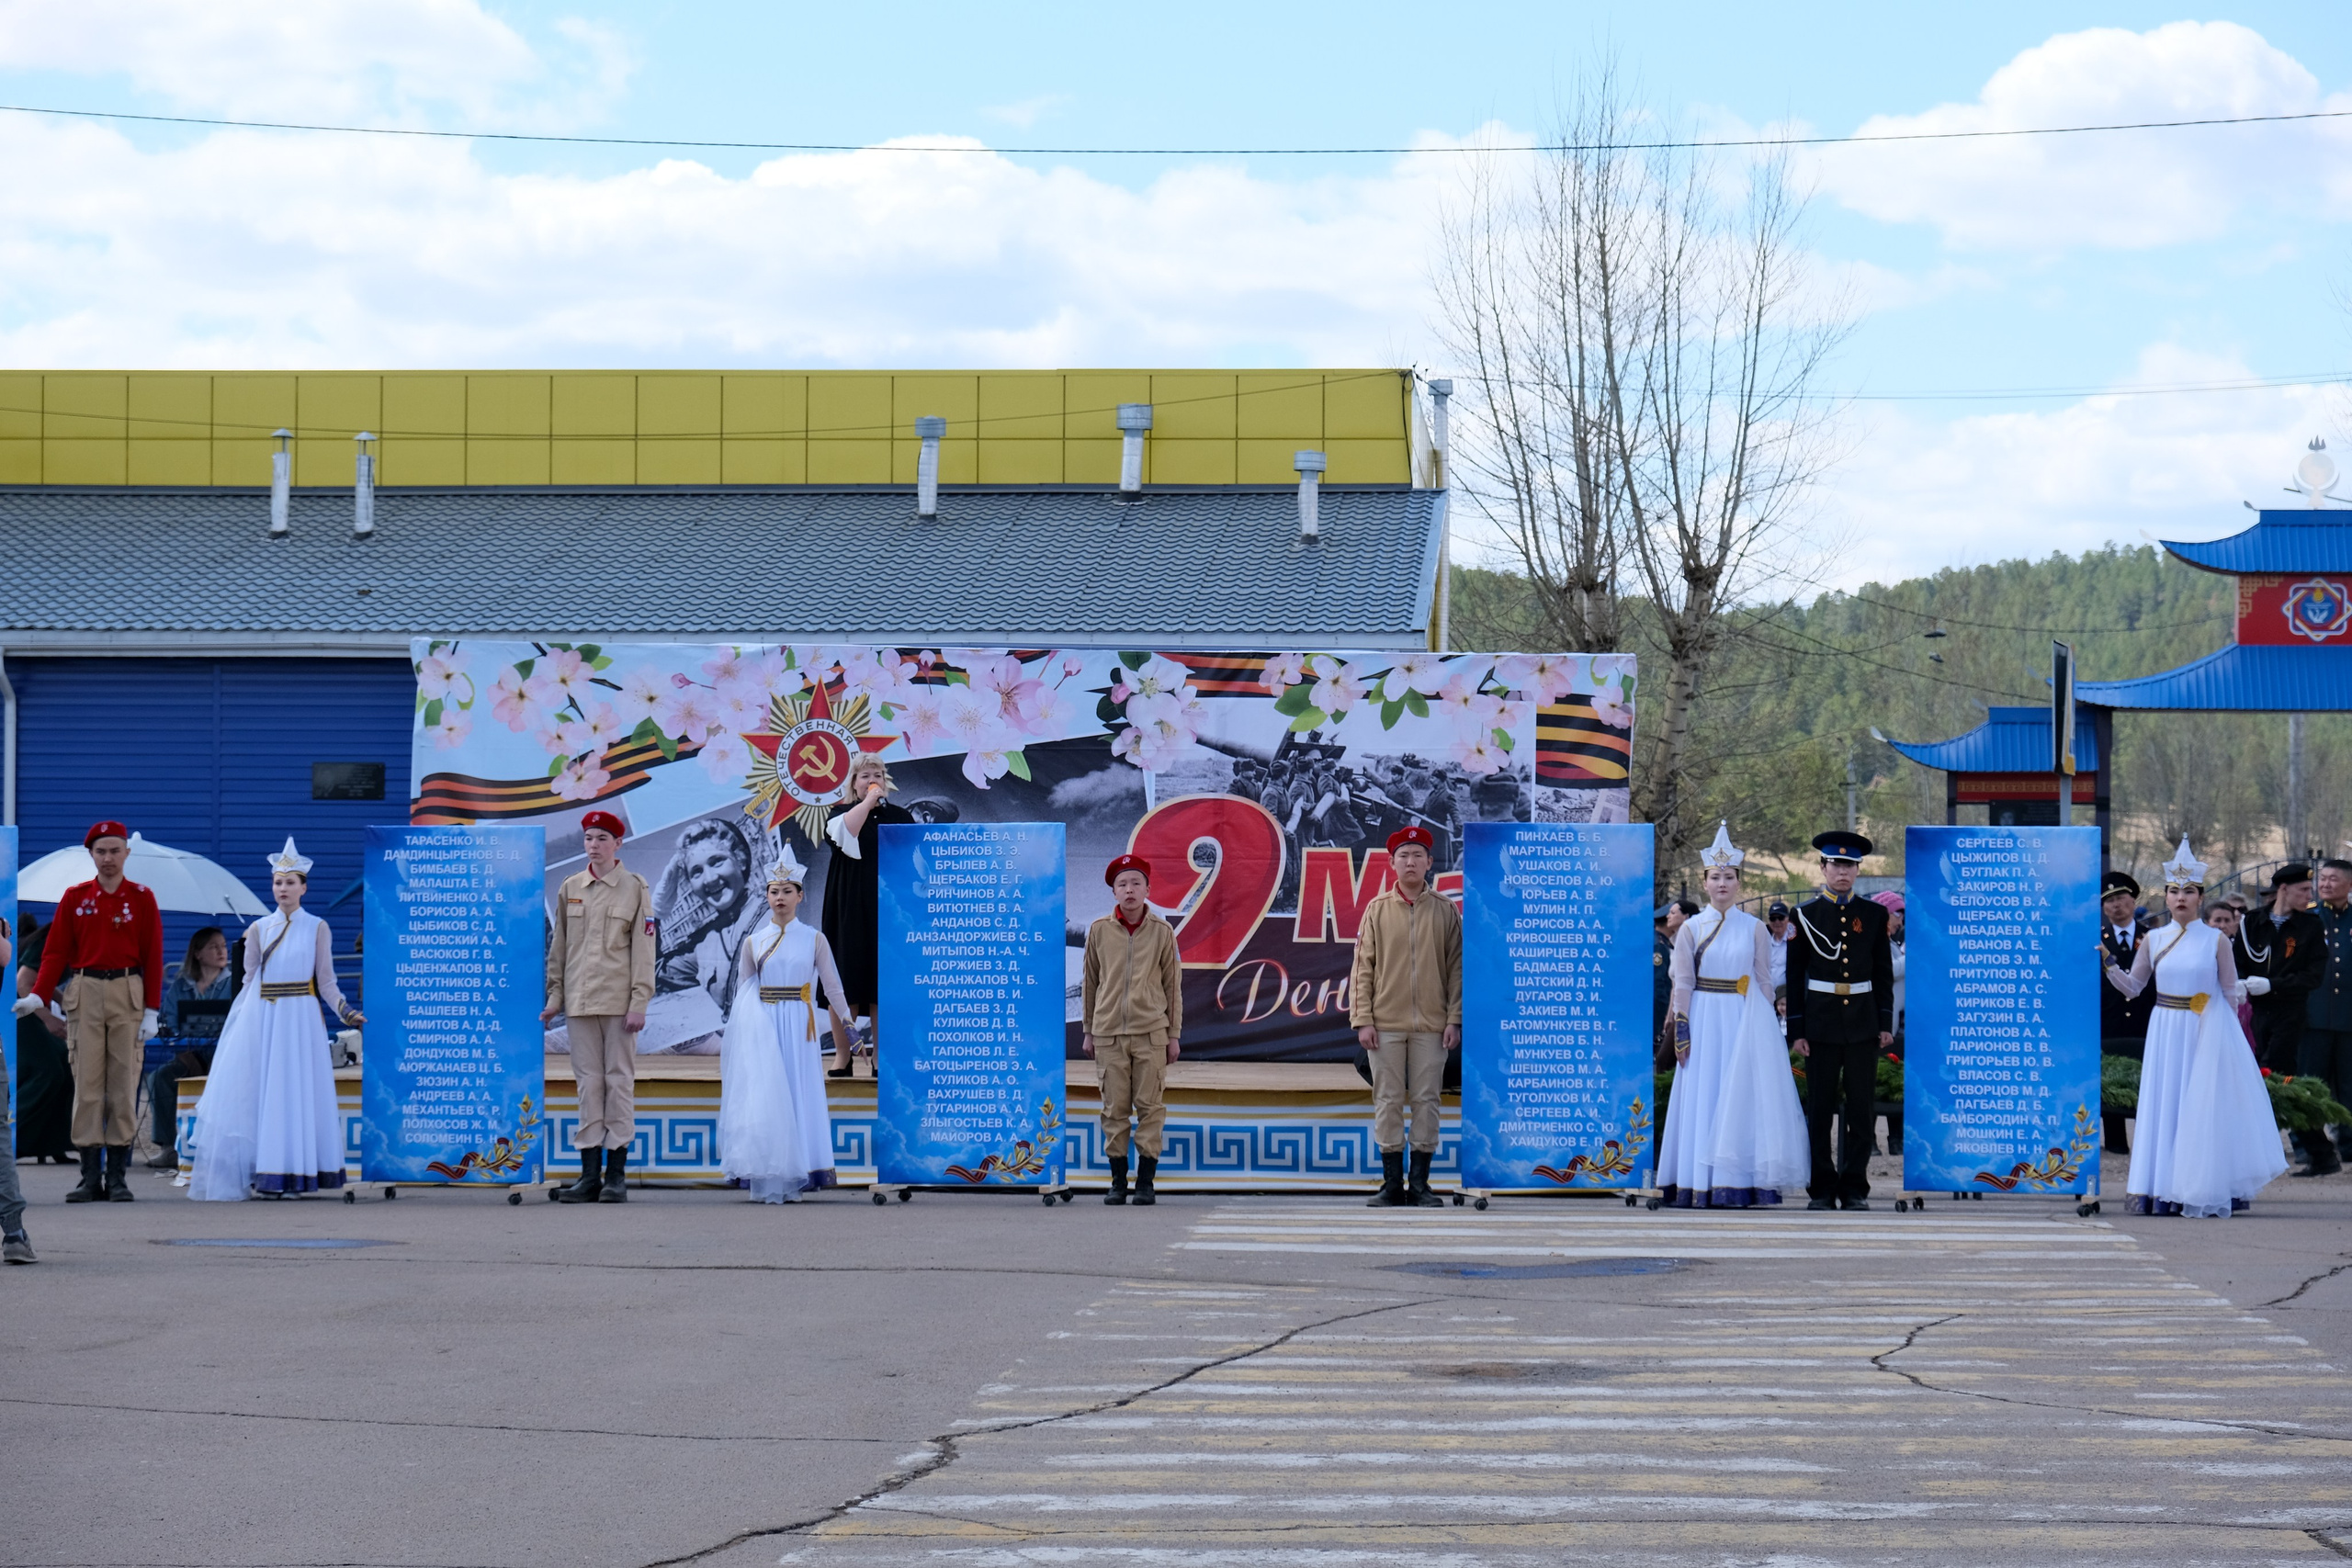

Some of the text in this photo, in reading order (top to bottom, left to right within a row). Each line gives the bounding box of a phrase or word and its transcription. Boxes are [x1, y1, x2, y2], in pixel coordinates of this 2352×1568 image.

[778, 721, 854, 796] ОТЕЧЕСТВЕННАЯ
[404, 836, 473, 845] ТАРАСЕНКО
[923, 832, 999, 841] АФАНАСЬЕВ
[1516, 832, 1574, 841] ПИНХАЕВ
[1956, 839, 2014, 848] СЕРГЕЕВ
[932, 846, 992, 857] ЦЫБИКОВ
[1510, 846, 1580, 855] МАРТЫНОВ
[383, 851, 492, 862] ДАМДИНЦЫРЕНОВ
[1951, 853, 2019, 864] ЦЫЖИПОВ
[410, 864, 467, 874] БИМБАЕВ
[935, 861, 987, 870] БРЫЛЕВ
[1519, 861, 1571, 870] УШАКОВ
[1962, 867, 2010, 876] БУГЛАК
[410, 878, 469, 887] МАЛАШТА
[929, 874, 997, 886] ЩЕРБАКОВ
[1126, 793, 1287, 970] 9
[1503, 875, 1581, 885] НОВОСЕЛОВ
[1956, 882, 2016, 891] ЗАКИРОВ
[399, 893, 506, 902] ЛИТВИНЕНКО А. В.
[928, 889, 1024, 898] РИНЧИНОВ А. А.
[1522, 890, 1597, 900] ЮРЬЕВ А. В.
[1951, 897, 2051, 907] БЕЛОУСОВ В. А.
[410, 907, 495, 916] БОРИСОВ А. А.
[928, 903, 1024, 912] ВИТЮТНЕВ В. А.
[1523, 905, 1596, 915] МУЛИН Н. П.
[1958, 911, 2043, 922] ЩЕРБАК О. И.
[409, 921, 496, 932] ЦЫБИКОВ С. Д.
[931, 918, 991, 929] АНДАНОВ
[1514, 919, 1604, 929] БОРИСОВ А. А.
[1949, 926, 2021, 937] ШАБАДАЕВ
[399, 932, 507, 944] ЕКИМОВСКИЙ А. А.
[906, 932, 1046, 943] ДАНЗАНДОРЖИЕВ С. Б.
[1506, 933, 1612, 943] КРИВОШЕЕВ М. Р.
[1959, 940, 2042, 950] ИВАНОВ А. Е.
[410, 950, 494, 959] ВАСЮКОВ Г. В.
[922, 946, 985, 955] МИТЫПОВ
[1019, 946, 1030, 955] Ч.
[1509, 948, 1610, 959] КАШИРЦЕВ А. О.
[1959, 954, 2042, 964] КАРПОВ Э. М.
[396, 964, 509, 975] ЦЫДЕНЖАПОВ М. Г.
[931, 961, 992, 972] ДОРЖИЕВ
[1514, 963, 1575, 974] БАДМАЕВ
[1950, 969, 2017, 978] ПРИТУПОВ
[395, 977, 481, 987] ЛОСКУТНИКОВ
[914, 976, 1009, 987] БАЛДАНЖАПОВ
[1514, 975, 1574, 987] ШАТСКИЙ
[929, 989, 1023, 998] КОРНАКОВ В. И.
[1954, 984, 2016, 993] АБРАМОВ
[406, 992, 469, 1001] ВАСИЛЬЕВ
[1515, 991, 1572, 1002] ДУГАРОВ
[1956, 998, 2045, 1009] КИРИКОВ Е. В.
[409, 1006, 495, 1015] БАШЛЕЕВ Н. А.
[933, 1004, 989, 1015] ДАГБАЕВ
[1519, 1006, 1599, 1016] ЗАКИЕВ М. И.
[1957, 1012, 2043, 1022] ЗАГУЗИН В. А.
[401, 1020, 459, 1029] ЧИМИТОВ
[933, 1018, 1019, 1029] КУЛИКОВ Д. В.
[1500, 1021, 1617, 1031] БАТОМУНКУЕВ В. Г.
[1951, 1027, 2019, 1036] ПЛАТОНОВ
[408, 1034, 467, 1043] СМИРНОВ
[928, 1032, 1023, 1042] ПОХОЛКОВ И. Н.
[1512, 1035, 1604, 1045] ШИРАПОВ Б. Н.
[933, 1046, 990, 1055] ГАПОНОВ
[1949, 1042, 2020, 1051] ЛАРИОНОВ
[404, 1049, 469, 1060] ДОНДУКОВ
[1514, 1050, 1572, 1059] МУНКУЕВ
[1946, 1056, 2055, 1066] ГРИГОРЬЕВ Ю. В.
[397, 1063, 477, 1072] АЮРЖАНАЕВ
[913, 1061, 1009, 1072] БАТОЦЫРЕНОВ
[1510, 1064, 1575, 1073] ШЕШУКОВ
[933, 1076, 989, 1085] КУЛИКОВ
[1959, 1071, 2011, 1080] ВЛАСОВ
[416, 1077, 458, 1086] ЗЮЗИН
[1508, 1078, 1583, 1088] КАРБАИНОВ
[409, 1091, 465, 1102] АНДРЕЕВ
[927, 1089, 995, 1099] ВАХРУШЕВ
[1949, 1086, 2018, 1097] СКВОРЦОВ
[1507, 1093, 1578, 1102] ТУГОЛУКОВ
[402, 1105, 474, 1114] МЕХАНТЬЕВ
[925, 1104, 997, 1113] ТУГАРИНОВ
[1955, 1100, 2014, 1109] ПАГБАЕВ
[1515, 1108, 1571, 1117] СЕРГЕЕВ
[922, 1118, 1003, 1127] ЗЛЫГОСТЬЕВ
[1940, 1111, 2029, 1125] БАЙБОРОДИН
[1498, 1122, 1583, 1134] ДМИТРИЕНКО
[931, 1130, 991, 1142] МАЙОРОВ
[1956, 1129, 2013, 1138] МОШКИН
[1510, 1134, 1577, 1148] ХАЙДУКОВ
[1953, 1144, 2014, 1153] ЯКОВЛЕВ
